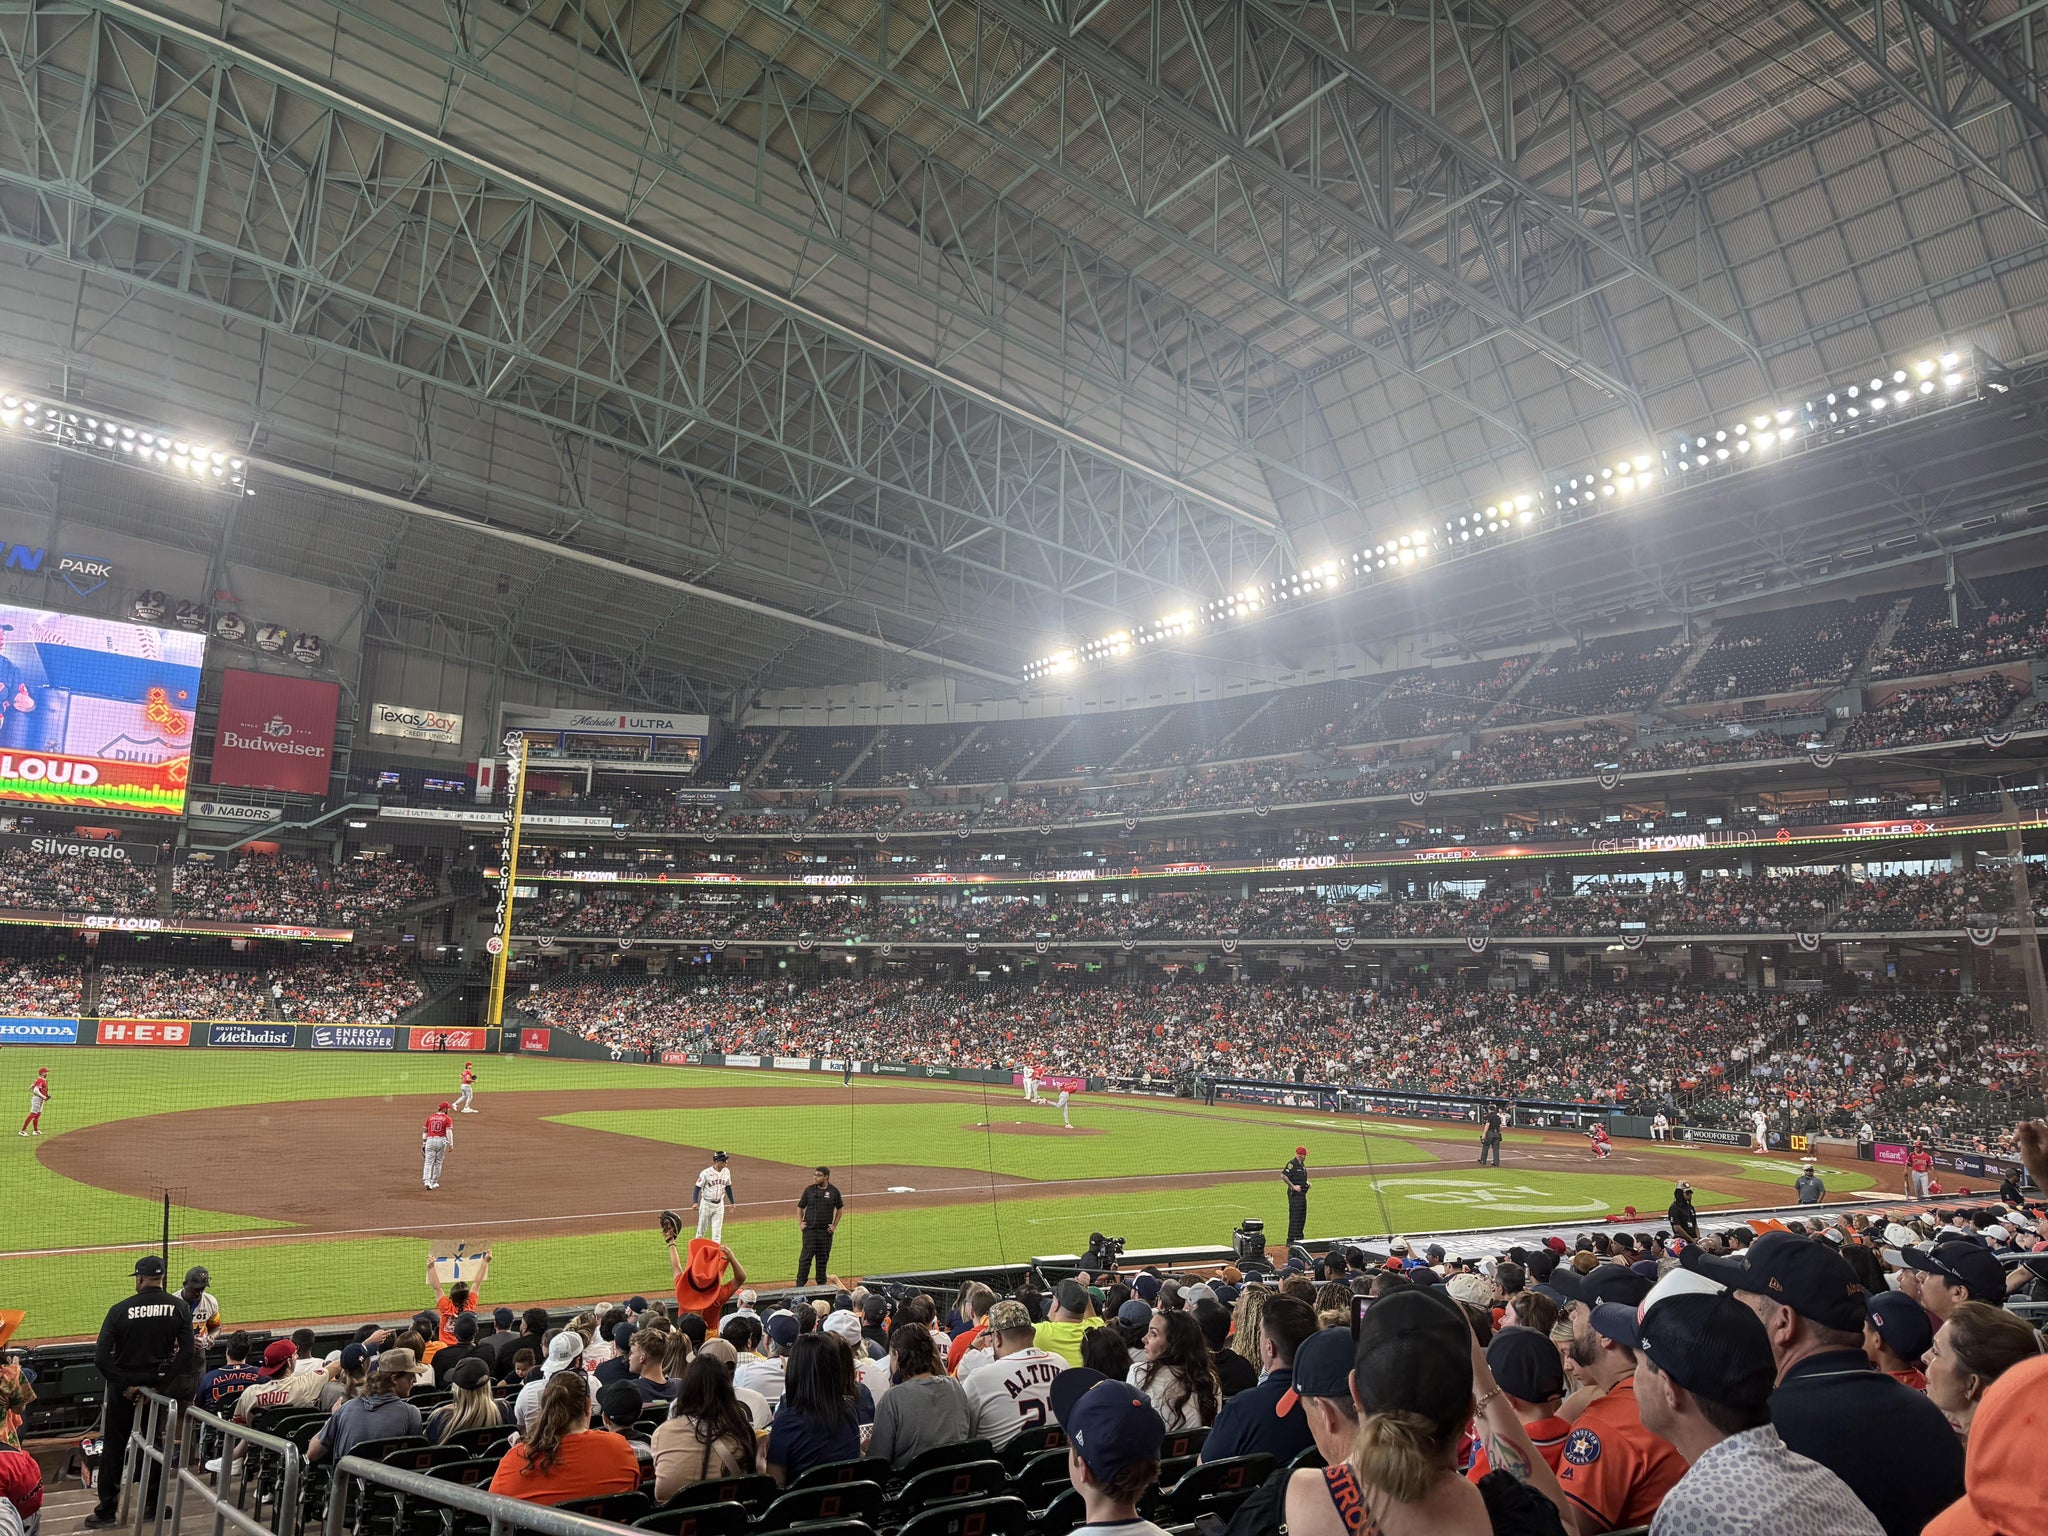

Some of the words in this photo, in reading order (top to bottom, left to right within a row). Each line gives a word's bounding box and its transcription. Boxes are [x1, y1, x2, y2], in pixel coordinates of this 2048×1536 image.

[59, 558, 112, 578] PARK
[225, 612, 238, 629] 5
[265, 622, 279, 640] 7
[378, 705, 420, 727] Texas
[426, 711, 457, 734] Bay
[569, 714, 617, 728] Michelob
[629, 718, 674, 730] ULTRA
[403, 728, 428, 738] CREDIT
[428, 733, 453, 741] UNION
[1, 755, 99, 785] LOUD
[217, 806, 271, 819] NABORS
[31, 838, 125, 860] Silverado
[1638, 833, 1705, 851] H-TOWN
[1278, 858, 1301, 869] GET
[1302, 855, 1336, 867] LOUD
[573, 870, 617, 881] H-TOWN
[803, 875, 824, 884] GET
[825, 874, 854, 884] LOUD
[85, 915, 115, 929] GET
[118, 917, 162, 931] LOUD
[0, 1025, 75, 1036] HONDA
[214, 1028, 288, 1044] Methodist
[335, 1028, 382, 1038] ENERGY
[335, 1037, 392, 1047] TRANSFER
[431, 1120, 443, 1132] 10
[1693, 1130, 1739, 1141] WOODFOREST
[1879, 1151, 1901, 1160] reliant
[127, 1304, 175, 1320] SECURITY
[213, 1372, 259, 1386] ALVAREZ
[255, 1391, 289, 1407] TROUT
[1571, 1430, 1598, 1445] HOUSTON
